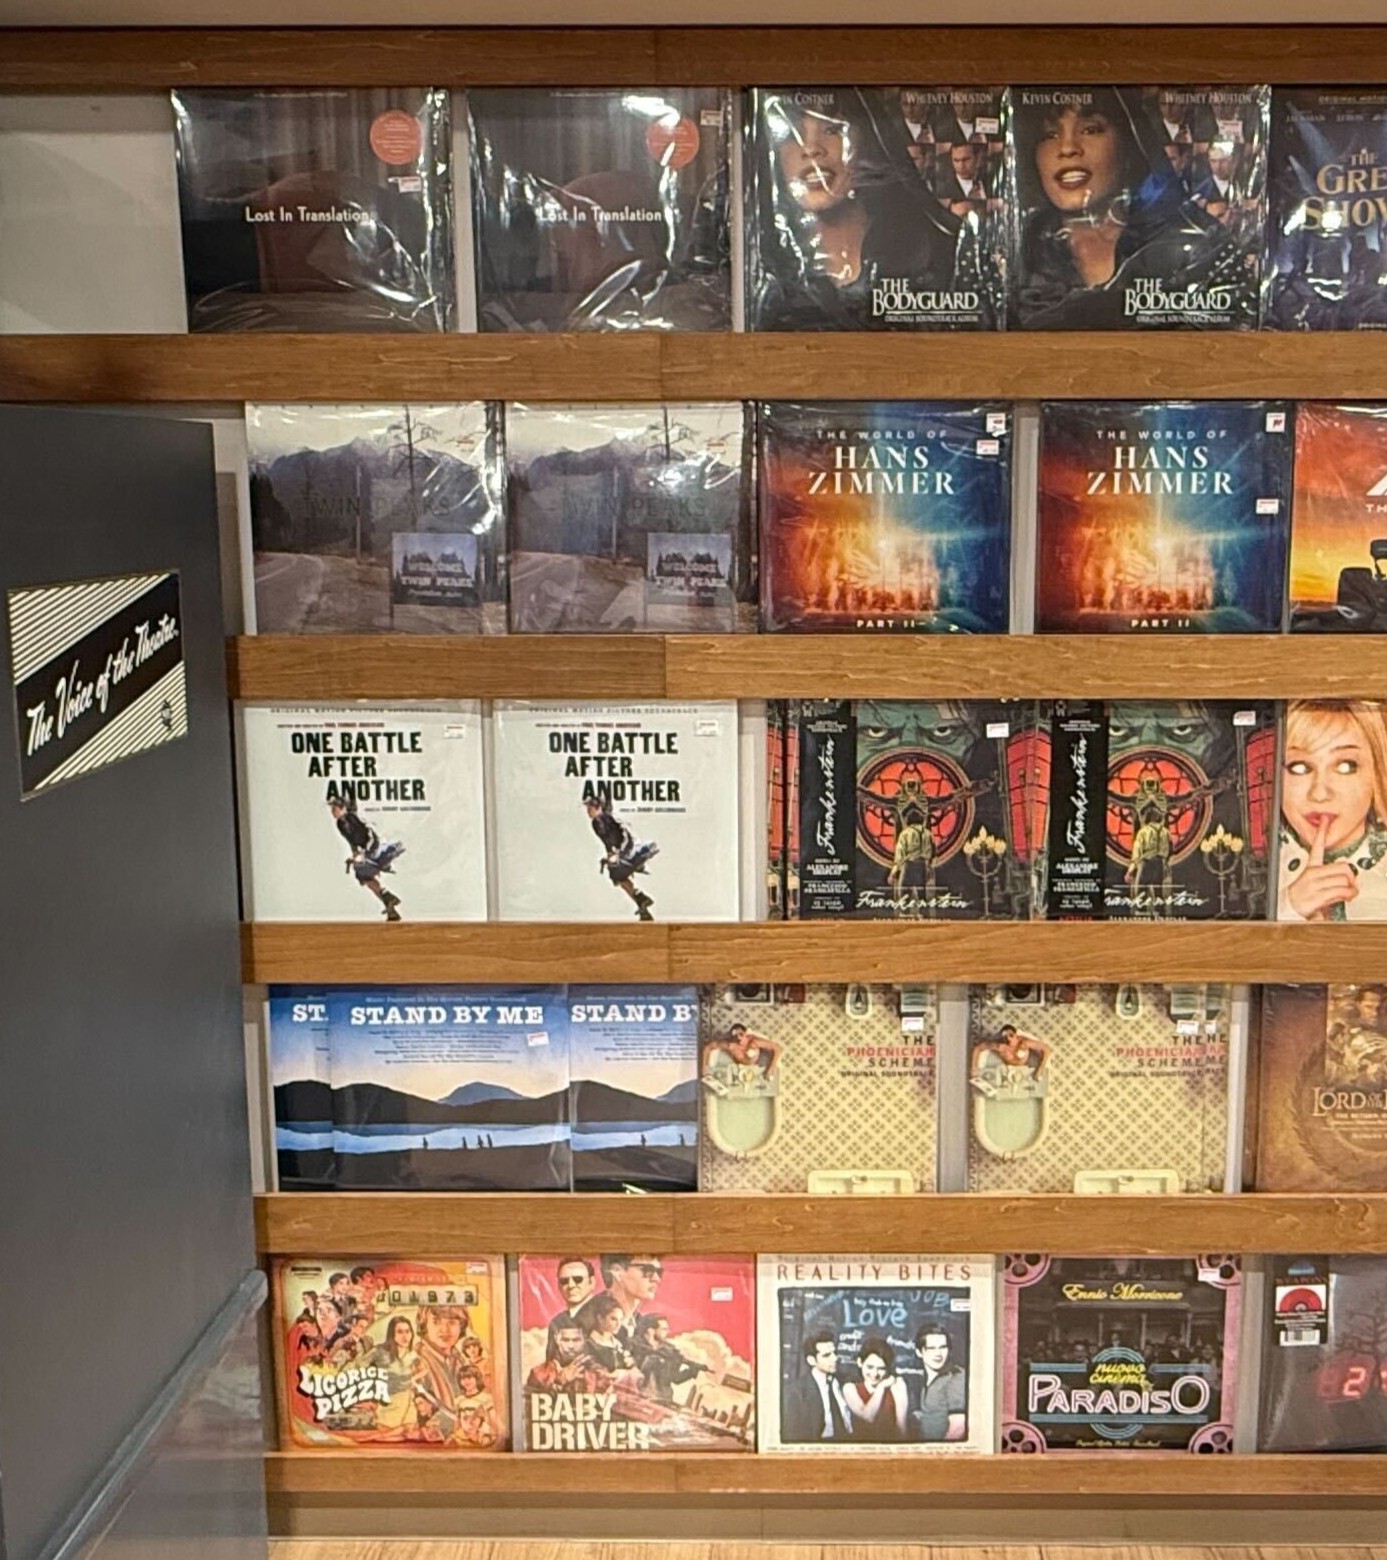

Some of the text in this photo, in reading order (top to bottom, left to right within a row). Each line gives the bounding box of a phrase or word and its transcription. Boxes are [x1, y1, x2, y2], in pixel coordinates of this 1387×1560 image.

[905, 92, 993, 104] WHITNEY HOUSTON
[1022, 92, 1093, 105] KEVIN COSTNER
[1165, 92, 1206, 104] WHITNEY
[1350, 152, 1377, 166] THE
[245, 206, 370, 222] Lost In Translation
[539, 206, 661, 222] Lost In Translation
[880, 278, 909, 293] THE
[1133, 278, 1162, 293] THE
[872, 288, 979, 316] BODYGUARD
[1124, 288, 1231, 316] BODYGUARD
[816, 430, 948, 440] THE WORLD OF
[1097, 430, 1228, 440] THE WORLD OF
[834, 446, 930, 469] HANS
[1114, 446, 1209, 469] HANS
[808, 472, 955, 495] ZIMMER
[1087, 472, 1233, 495] ZIMMER
[857, 619, 895, 628] PART
[1132, 619, 1169, 628] PART
[27, 700, 54, 756] The
[55, 659, 94, 739] Voice
[96, 653, 113, 714] of
[112, 637, 135, 685] the
[291, 732, 423, 753] ONE BATTLE
[549, 732, 678, 754] ONE BATTLE
[308, 756, 377, 777] AFTER
[565, 756, 633, 777] AFTER
[326, 779, 425, 801] ANOTHER
[582, 780, 680, 801] ANOTHER
[817, 733, 838, 857] Frankenstein
[1067, 732, 1088, 854] Frankenstein
[855, 890, 971, 910] Frankenstein
[351, 1005, 447, 1026] STAND
[453, 1005, 491, 1025] BY
[497, 1005, 545, 1025] ME
[571, 1004, 666, 1023] STAND
[903, 1035, 935, 1045] THE
[1171, 1036, 1202, 1045] THE
[847, 1047, 935, 1057] PHOENICIAN
[868, 1058, 936, 1068] SCHEME
[1138, 1058, 1203, 1067] SCHEME
[1312, 1087, 1366, 1116] LORD
[777, 1265, 971, 1281] REALITY BITES
[1062, 1282, 1183, 1301] Ennio Morricone
[843, 1300, 908, 1328] Love
[1095, 1363, 1145, 1373] nuovo
[299, 1363, 389, 1397] LICORICE
[1089, 1374, 1148, 1385] cinema
[315, 1380, 391, 1421] PIZZA
[1028, 1374, 1210, 1414] PARADISO
[531, 1393, 617, 1421] BABY
[531, 1422, 650, 1450] DRIVER
